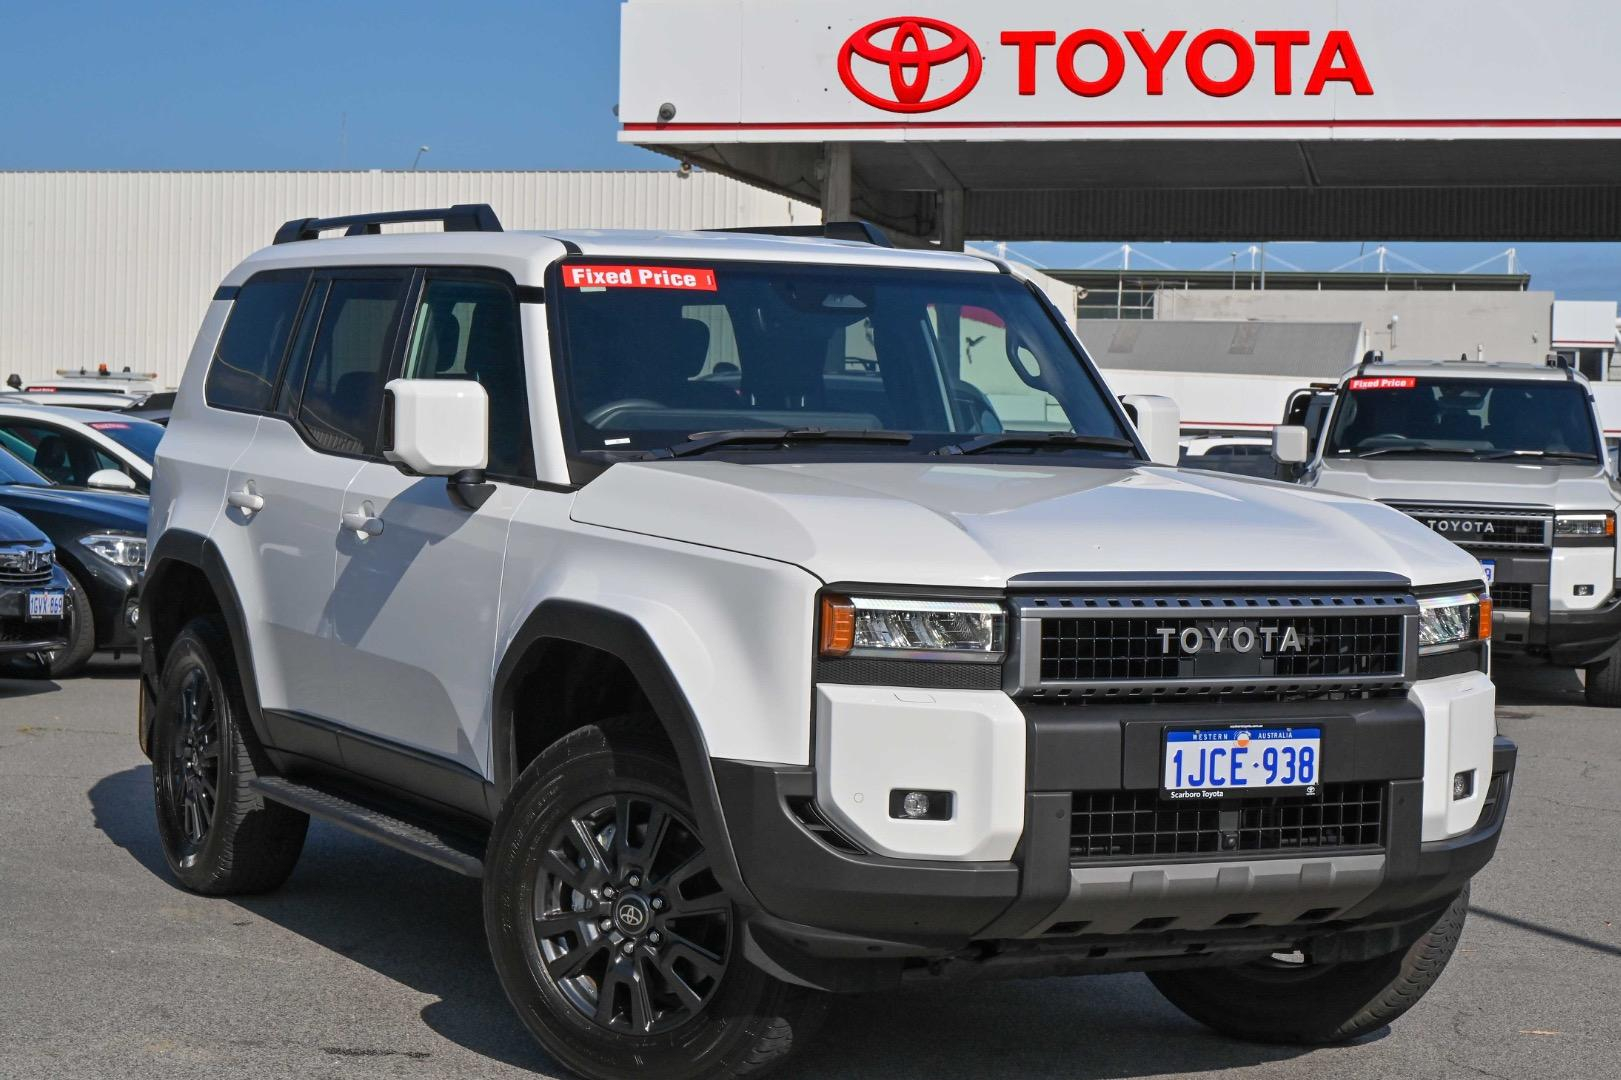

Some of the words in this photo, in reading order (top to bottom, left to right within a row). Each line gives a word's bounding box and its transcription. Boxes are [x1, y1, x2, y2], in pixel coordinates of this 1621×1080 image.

[1000, 28, 1374, 98] TOYOTA
[571, 268, 633, 285] Fixed
[638, 269, 697, 287] Price
[1353, 380, 1379, 389] Fixed
[1381, 379, 1407, 388] Price
[1427, 520, 1495, 533] TOYOTA
[1156, 626, 1302, 654] TOYOTA
[1192, 733, 1229, 741] WESTERN
[1257, 731, 1293, 740] AUSTRALIA
[1170, 790, 1201, 799] Scarboro
[1202, 790, 1224, 799] Toyota
